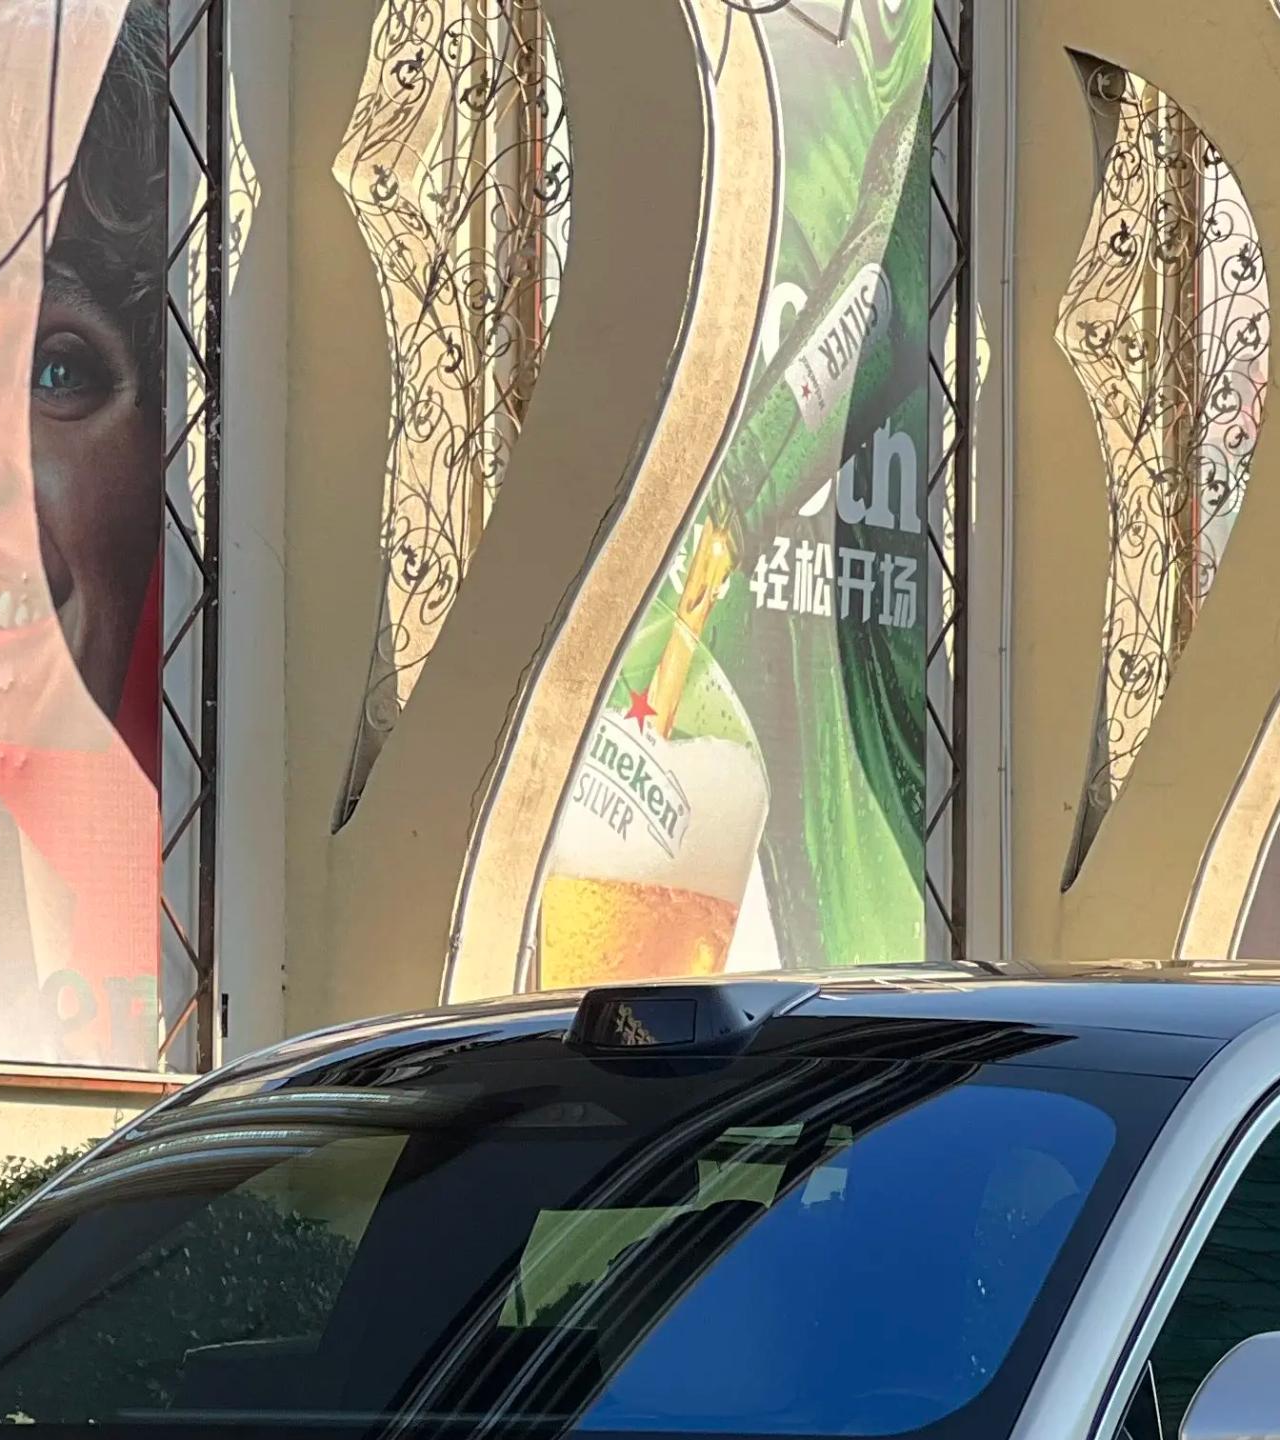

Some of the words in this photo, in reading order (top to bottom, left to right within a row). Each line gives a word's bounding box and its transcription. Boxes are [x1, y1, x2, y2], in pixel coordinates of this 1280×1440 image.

[818, 285, 878, 381] SILVER
[749, 536, 918, 630] 轻松开场
[573, 773, 634, 841] SILVER
